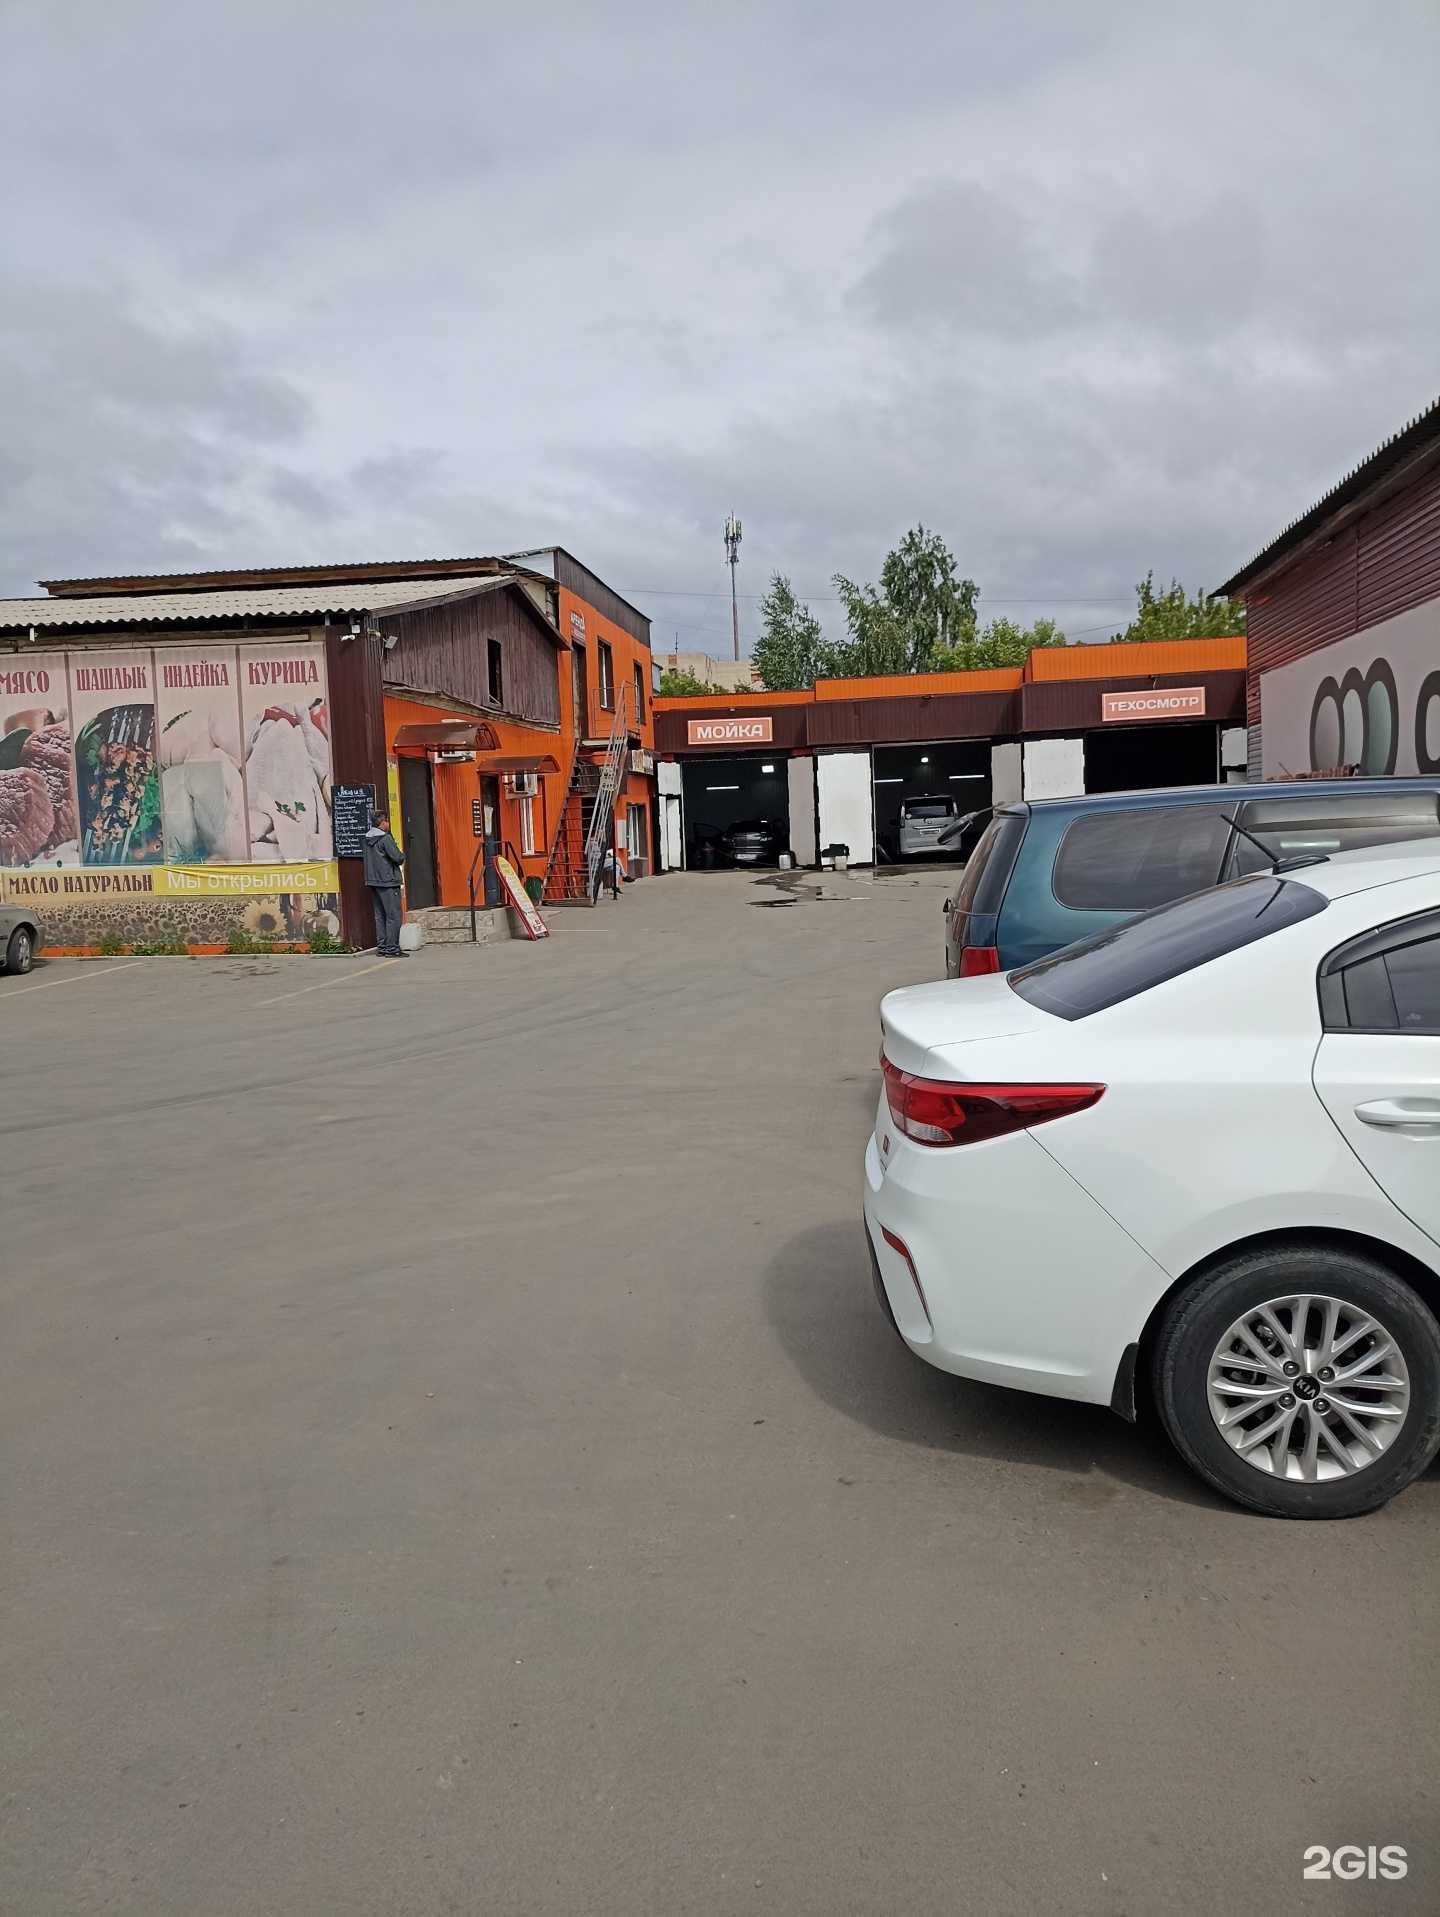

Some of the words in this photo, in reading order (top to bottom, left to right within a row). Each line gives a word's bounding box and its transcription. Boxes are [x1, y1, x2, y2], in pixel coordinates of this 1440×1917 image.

[0, 670, 50, 694] МЯСО
[76, 666, 147, 691] ШАШЛЫК
[163, 660, 229, 688] ИНДЕЙКА
[248, 660, 319, 685] КУРИЦА
[1108, 696, 1200, 713] ТЕХОСМОТР
[696, 721, 763, 740] МОЙКА
[9, 876, 59, 894] МАСЛО
[63, 874, 153, 893] НАТУРАЛЬН
[168, 871, 200, 889] Мы
[208, 870, 317, 892] открылись
[1296, 1379, 1316, 1398] KIA
